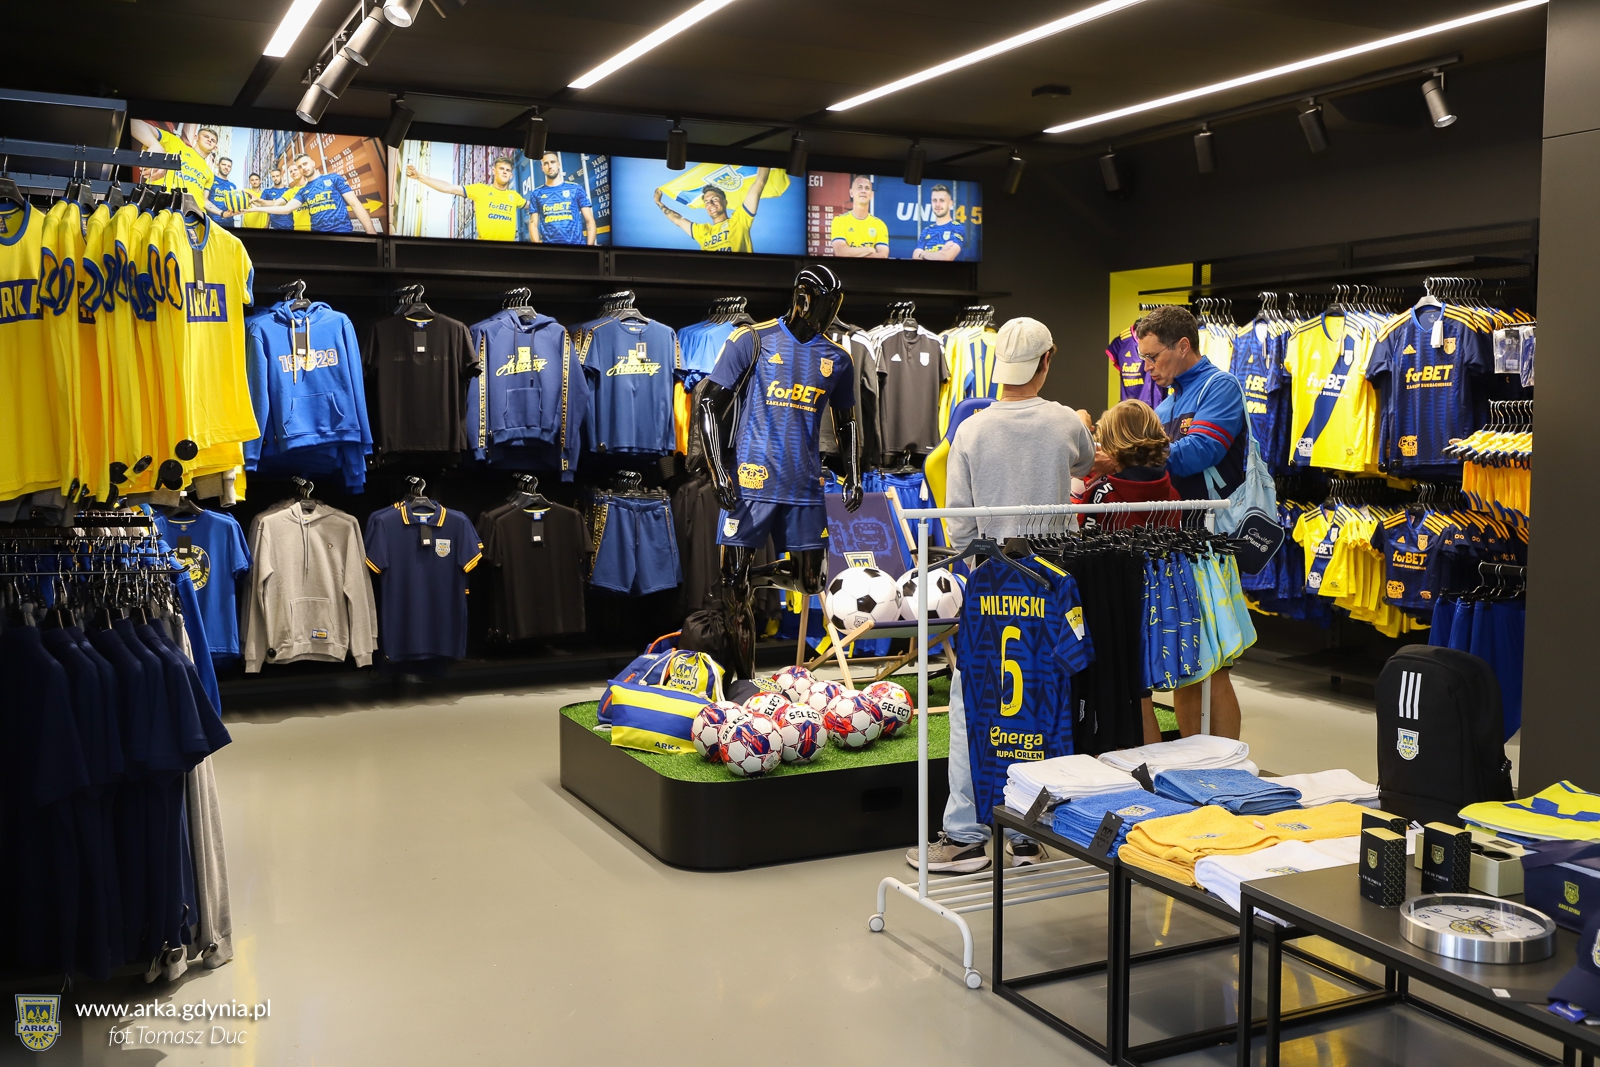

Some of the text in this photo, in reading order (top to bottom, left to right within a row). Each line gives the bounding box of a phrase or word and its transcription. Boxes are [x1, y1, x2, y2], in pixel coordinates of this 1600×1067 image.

[307, 190, 332, 205] forBET
[488, 202, 512, 212] forBET
[543, 201, 571, 212] forBET
[1306, 372, 1350, 391] forBET
[1405, 364, 1453, 383] forBET
[766, 380, 826, 404] forBET
[1393, 550, 1427, 565] forBET
[980, 595, 1045, 618] MILEWSKI
[1000, 625, 1023, 717] 6
[764, 694, 781, 716] ELECT
[881, 702, 910, 718] SELECT
[789, 710, 820, 721] SELECT
[722, 713, 749, 740] SELECT
[655, 741, 681, 750] ARKA
[1017, 751, 1042, 759] ORLEN
